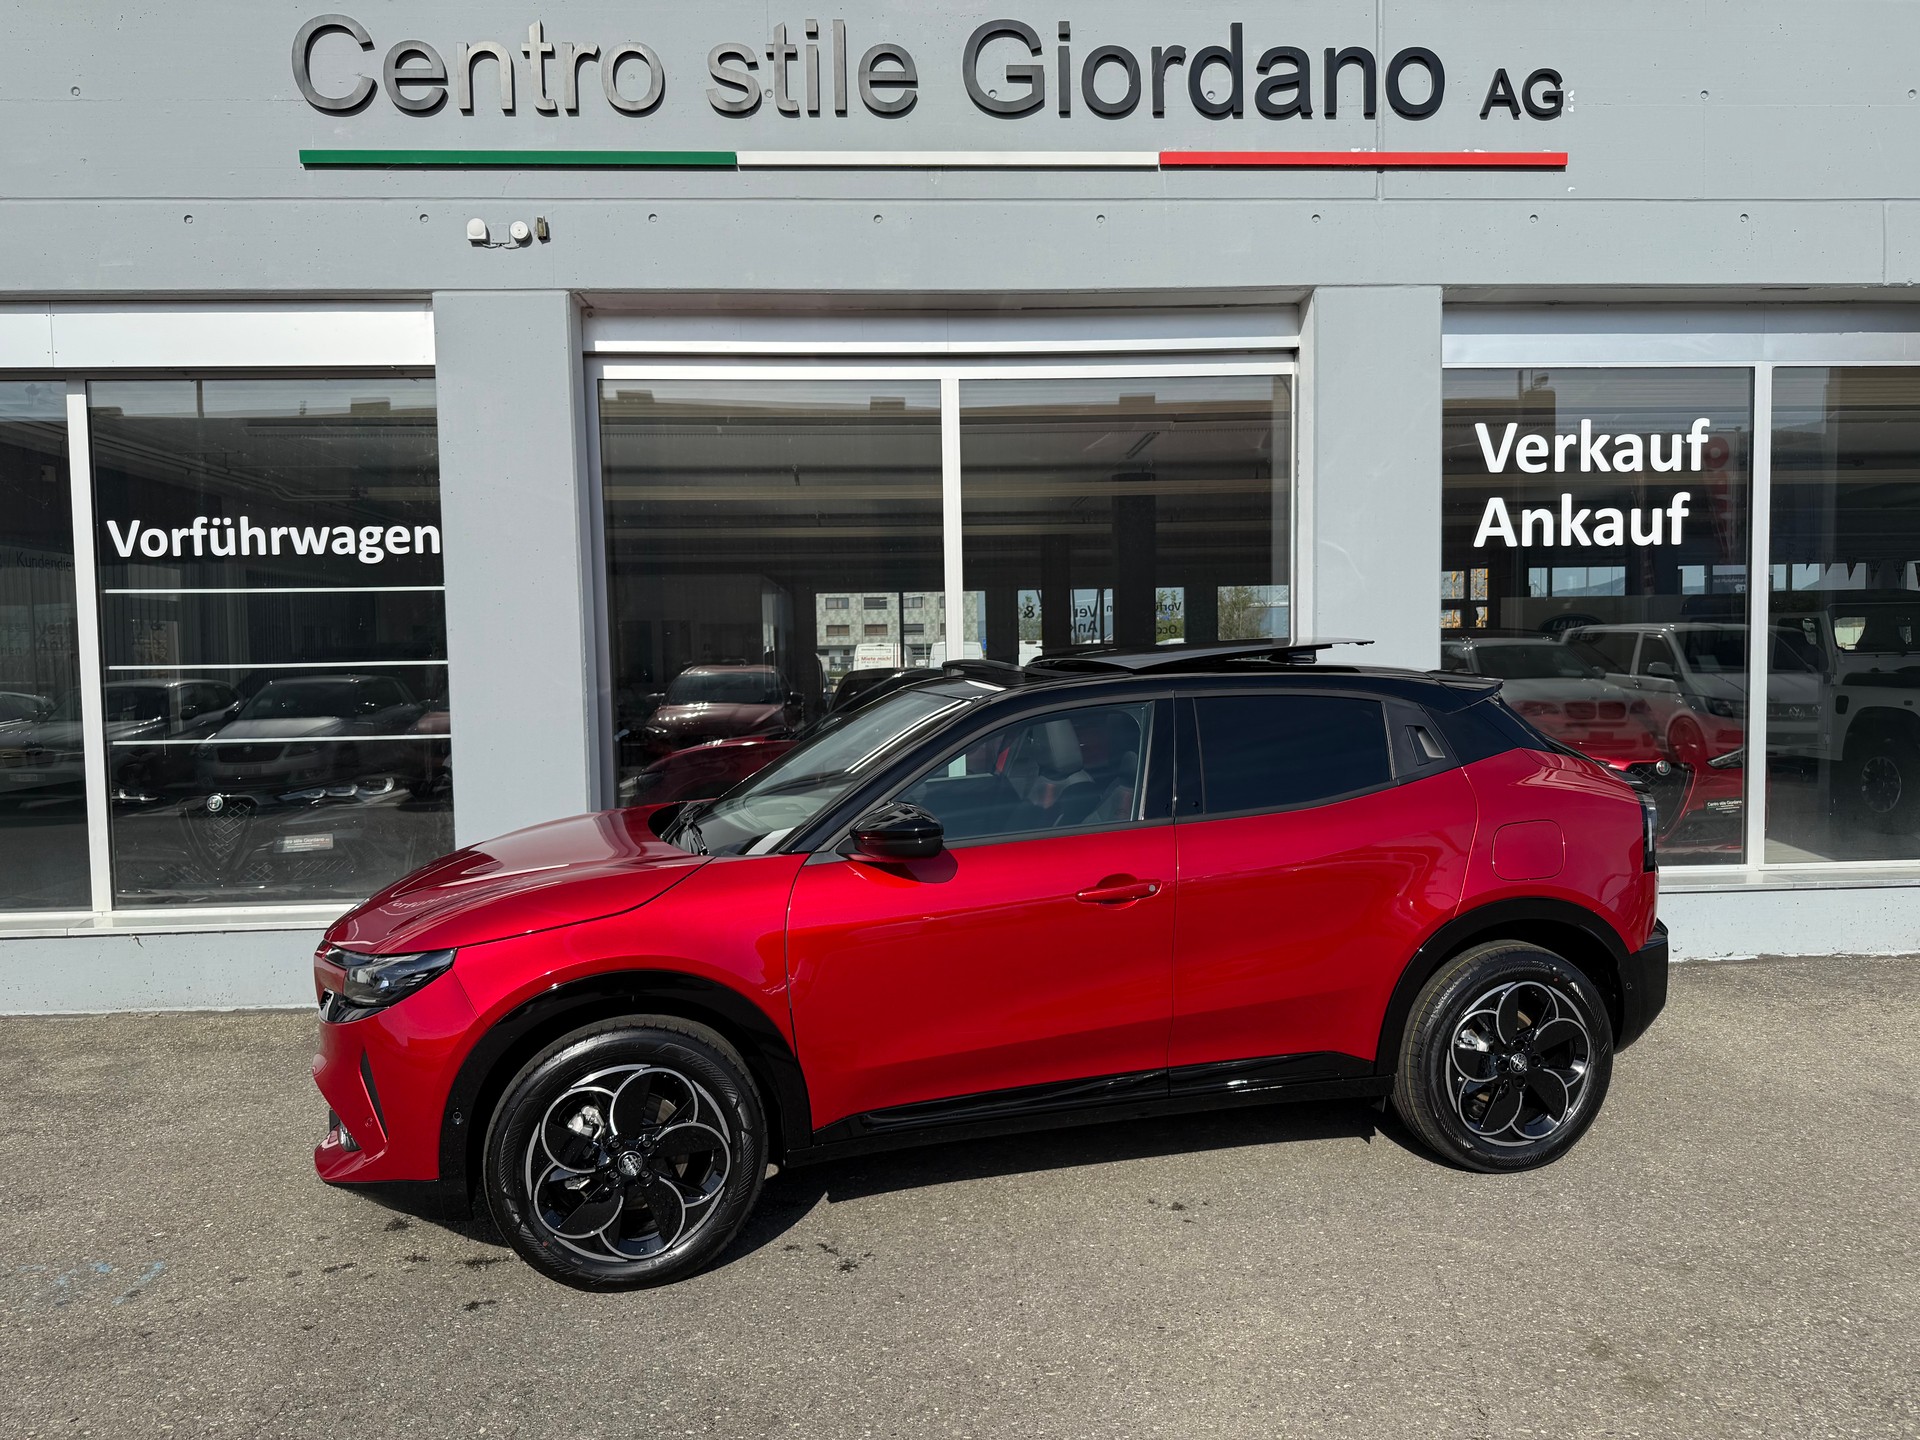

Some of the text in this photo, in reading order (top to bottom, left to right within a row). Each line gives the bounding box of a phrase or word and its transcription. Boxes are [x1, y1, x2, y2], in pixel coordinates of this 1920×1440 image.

[291, 13, 1566, 120] Centro stile Giordano AG
[1474, 418, 1710, 473] Verkauf
[107, 516, 441, 564] Vorführwagen
[1473, 492, 1691, 548] Ankauf
